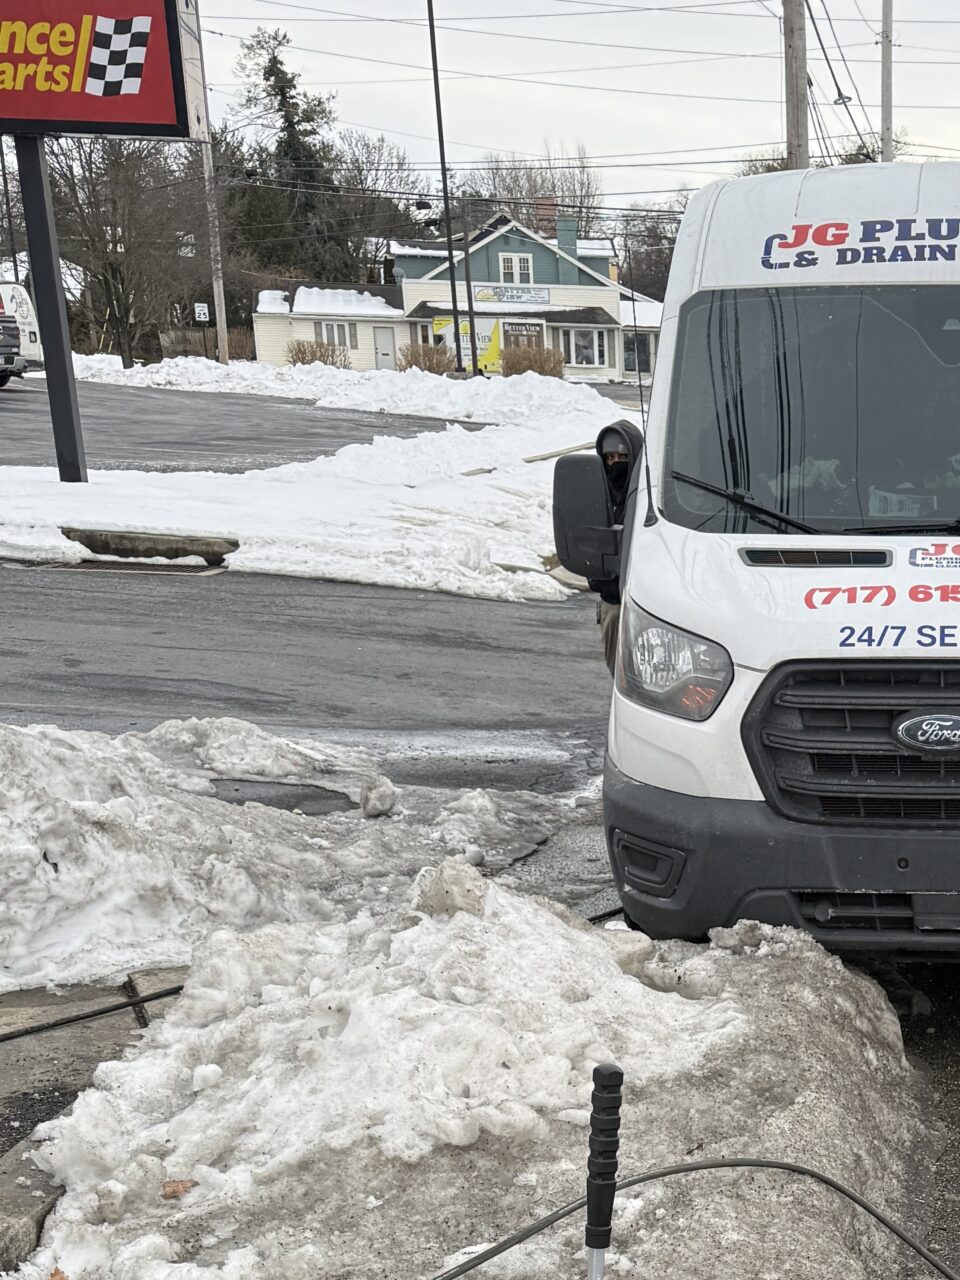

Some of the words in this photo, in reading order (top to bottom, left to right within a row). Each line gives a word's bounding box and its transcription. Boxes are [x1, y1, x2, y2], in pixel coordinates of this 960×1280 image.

[0, 20, 75, 56] nce
[0, 57, 70, 92] arts
[778, 222, 850, 249] JG
[793, 250, 819, 268] &
[836, 244, 957, 265] DRAIN
[804, 585, 897, 609] (717)
[839, 625, 907, 648] 24/7
